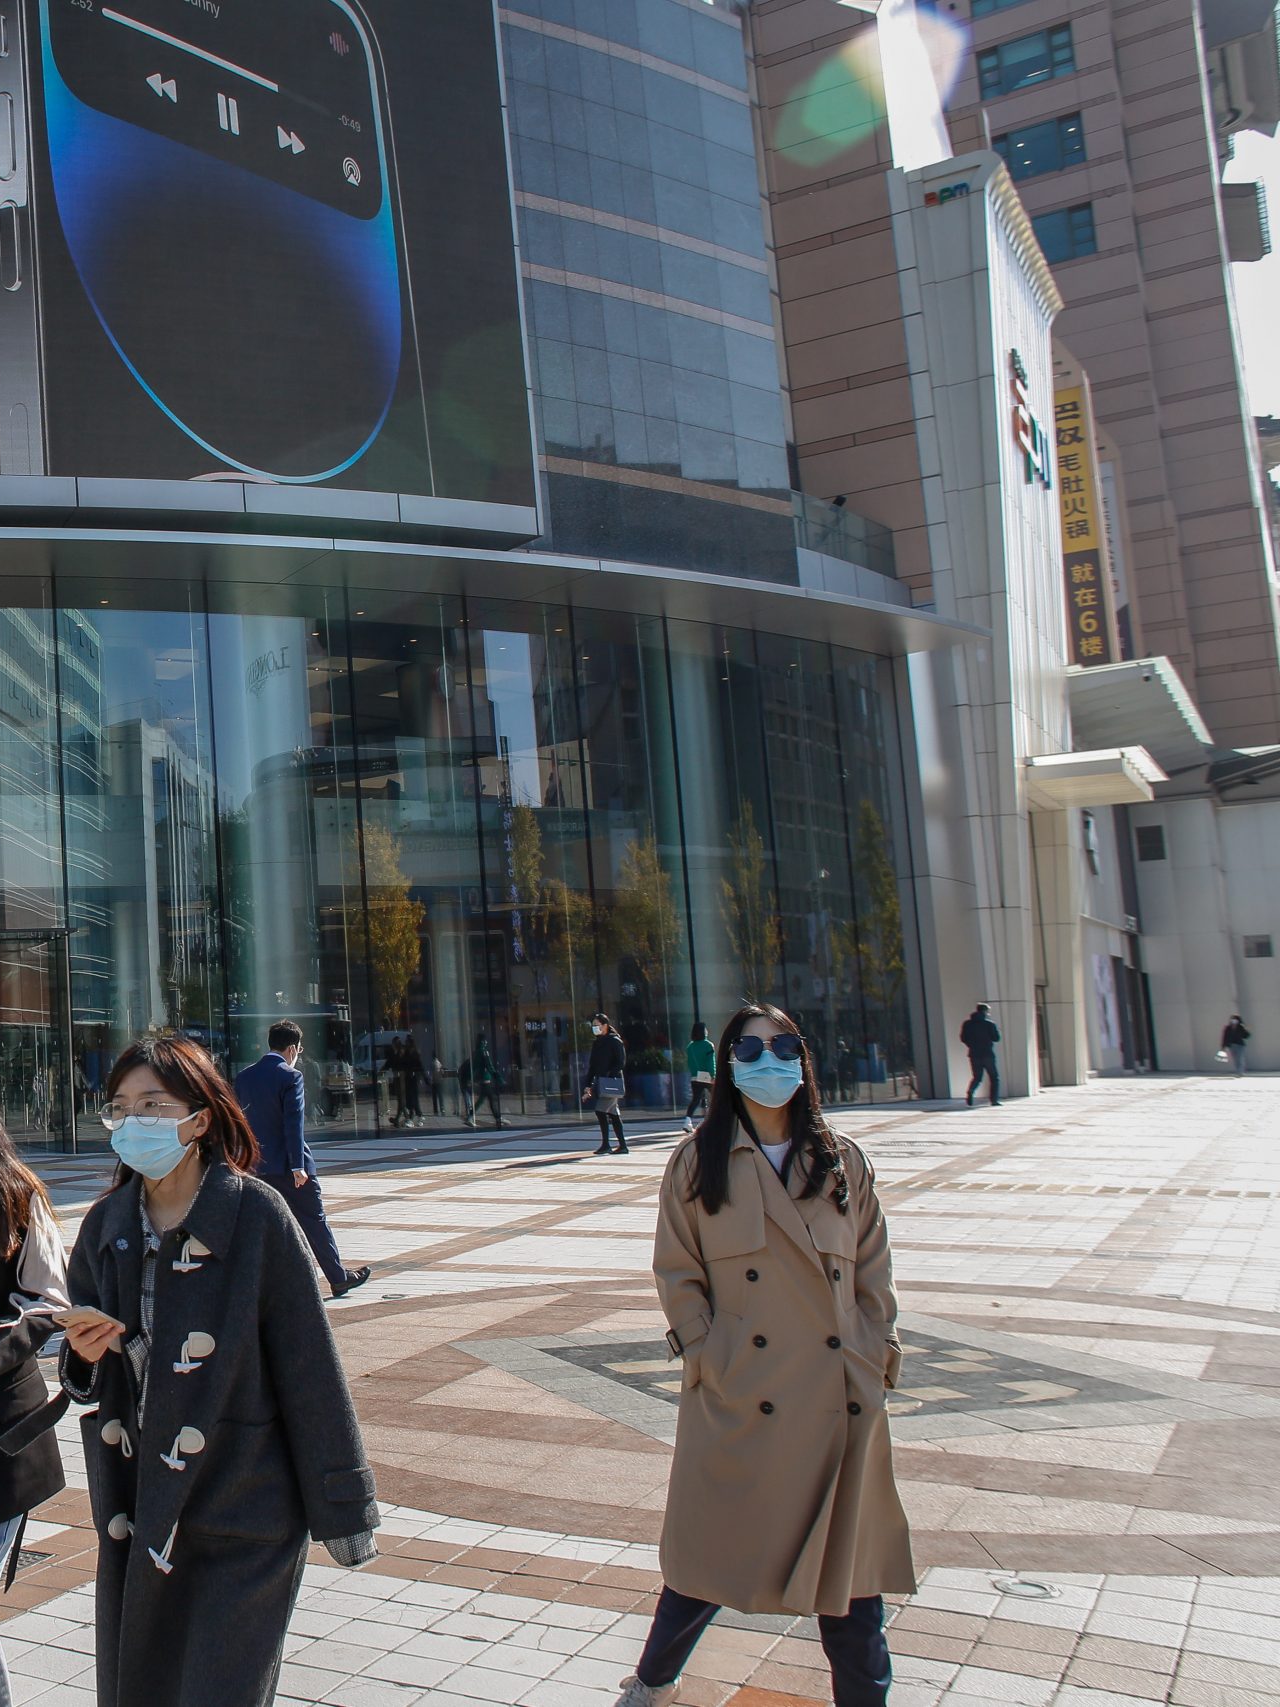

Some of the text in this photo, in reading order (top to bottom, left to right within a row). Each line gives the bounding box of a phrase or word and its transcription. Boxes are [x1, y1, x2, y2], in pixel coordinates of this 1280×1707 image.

[184, 0, 220, 18] unny
[1070, 562, 1104, 657] 就在6楼
